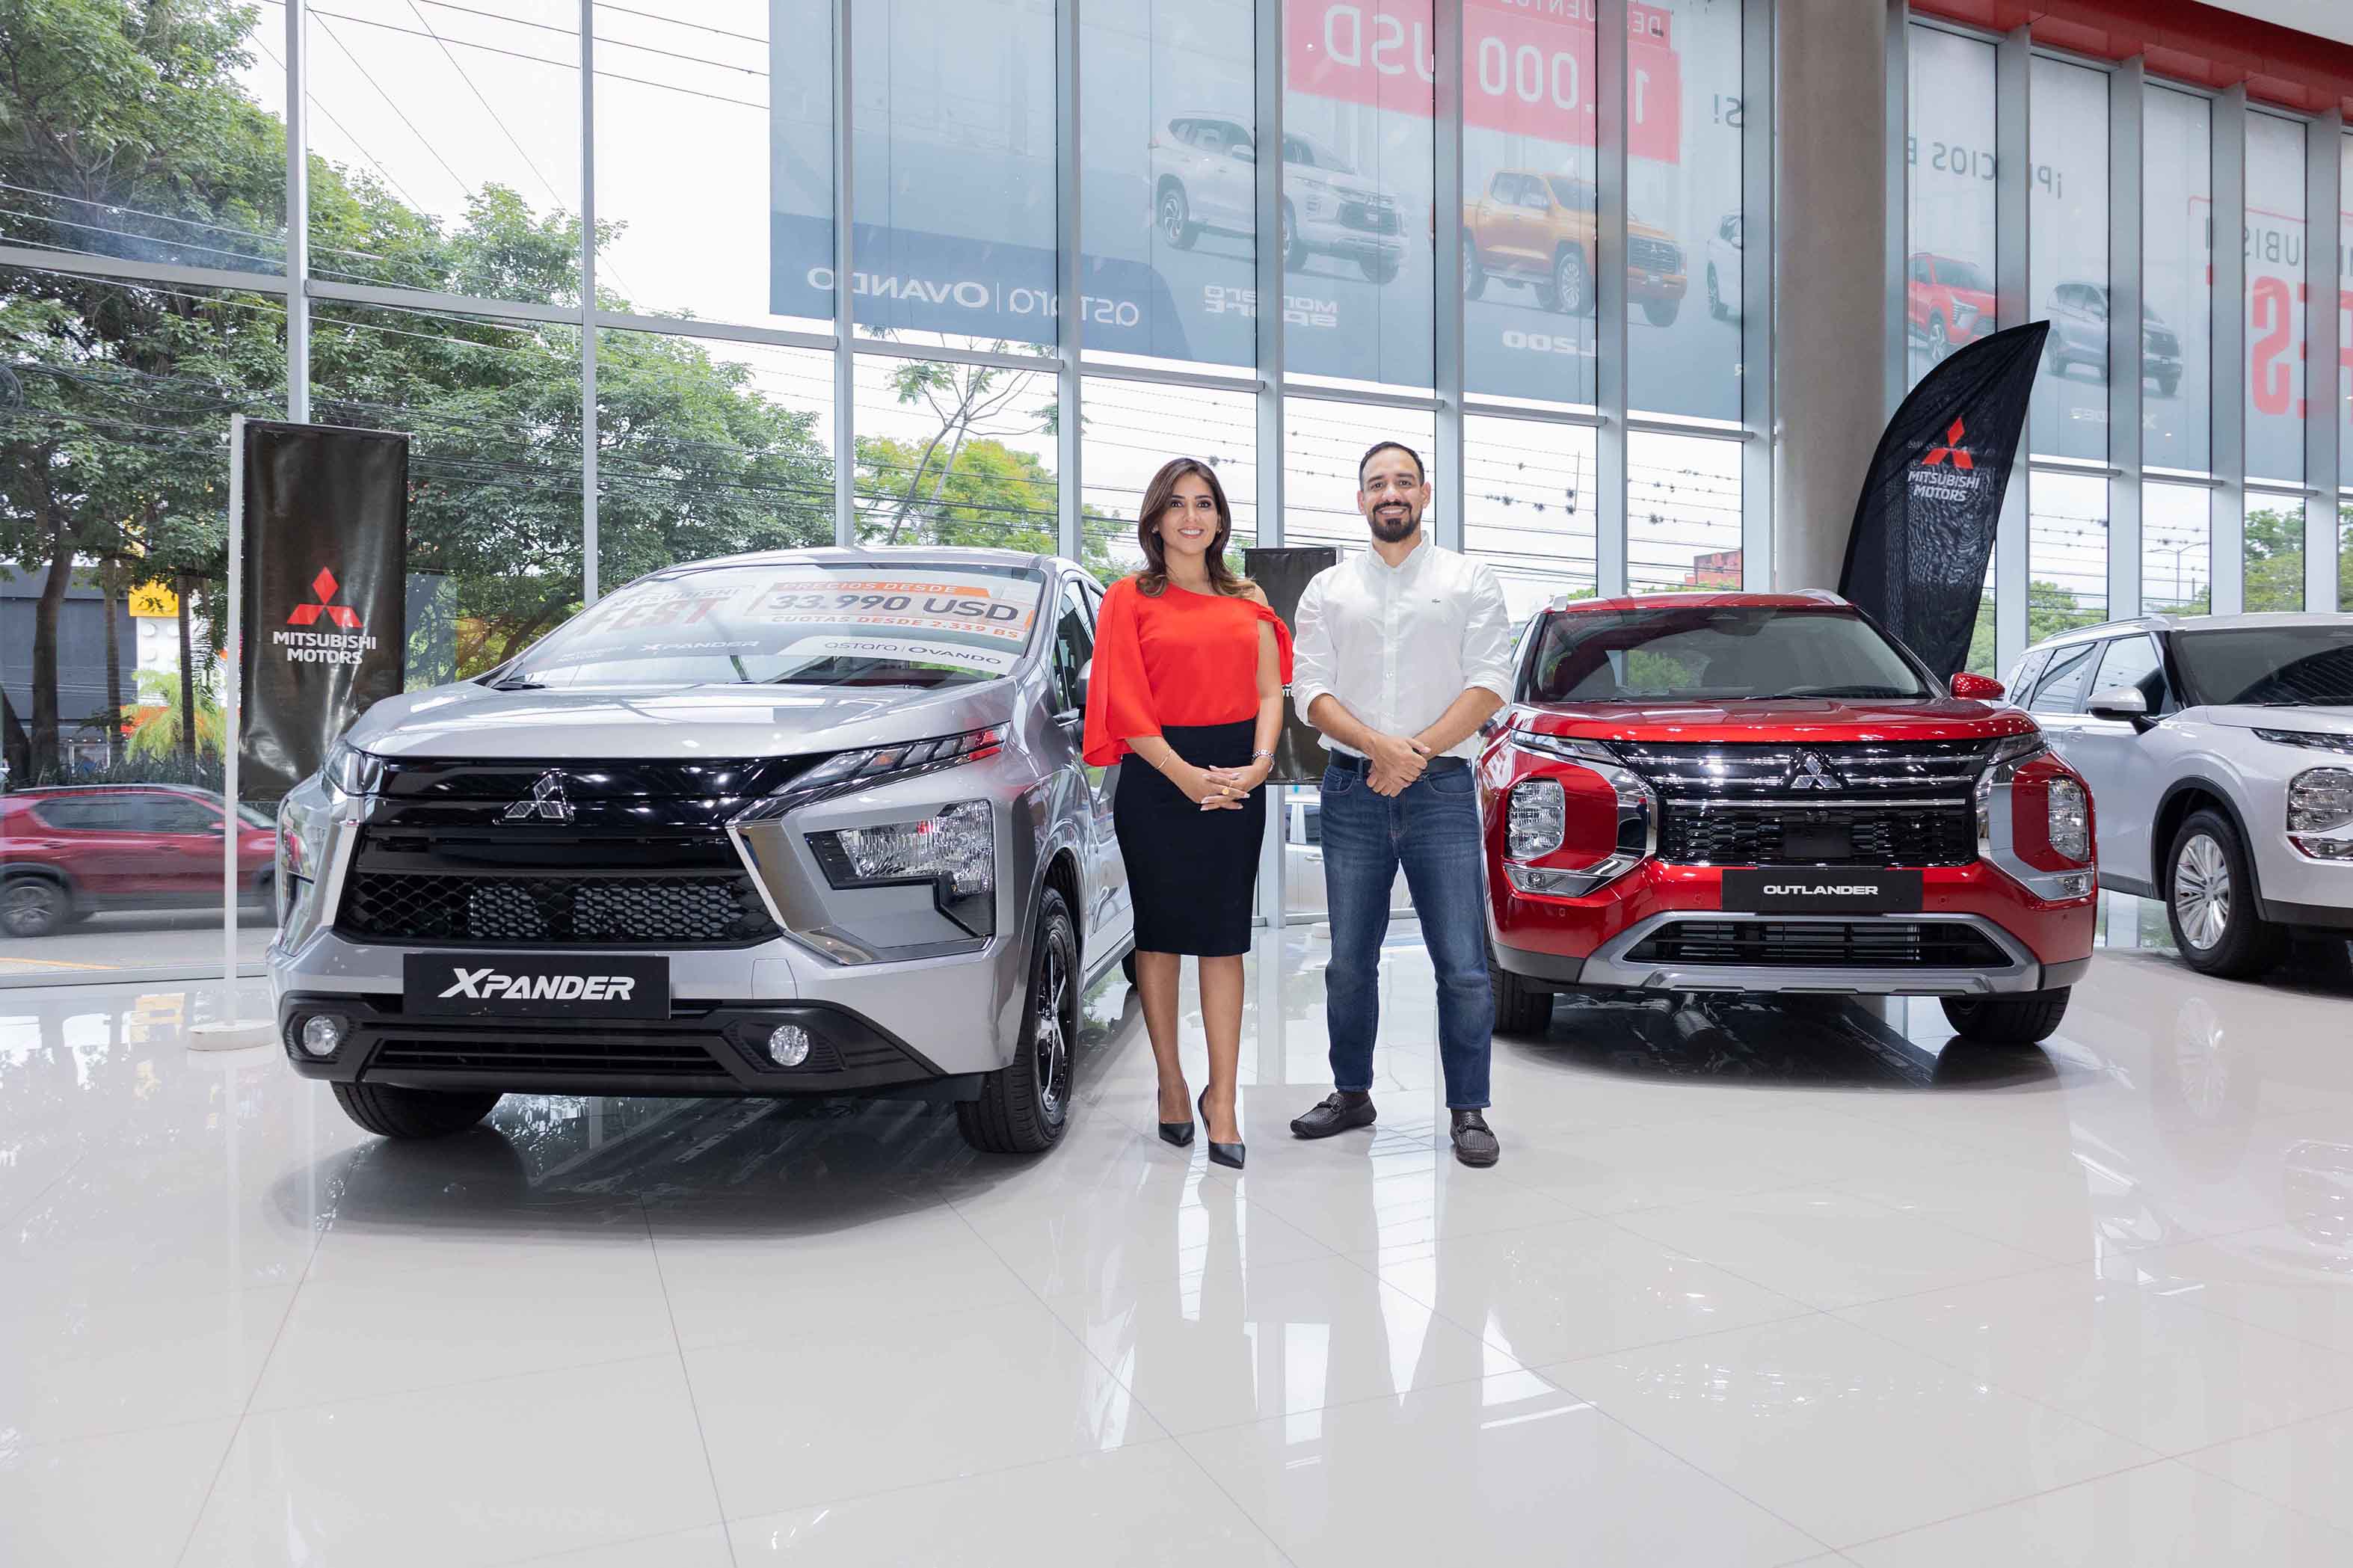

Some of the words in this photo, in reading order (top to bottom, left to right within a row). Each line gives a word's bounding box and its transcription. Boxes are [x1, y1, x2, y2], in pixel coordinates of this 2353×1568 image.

[1907, 470, 1980, 488] MITSUBISHI
[1913, 485, 1966, 502] MOTORS
[784, 582, 877, 593] PRECIOS
[882, 582, 959, 594] DESDE
[769, 595, 911, 611] 33.990
[922, 600, 1019, 621] USD
[857, 615, 923, 627] DESDE
[932, 621, 987, 633] 2.339
[993, 628, 1019, 639] BS
[272, 631, 377, 650] MITSUBISHI
[641, 640, 760, 657] XPANDER
[286, 648, 363, 665] MOTORS
[825, 640, 898, 652] astara
[908, 647, 1002, 665] OVANDO
[1763, 885, 1879, 895] OUTLANDER
[437, 968, 636, 1000] XPANDER
